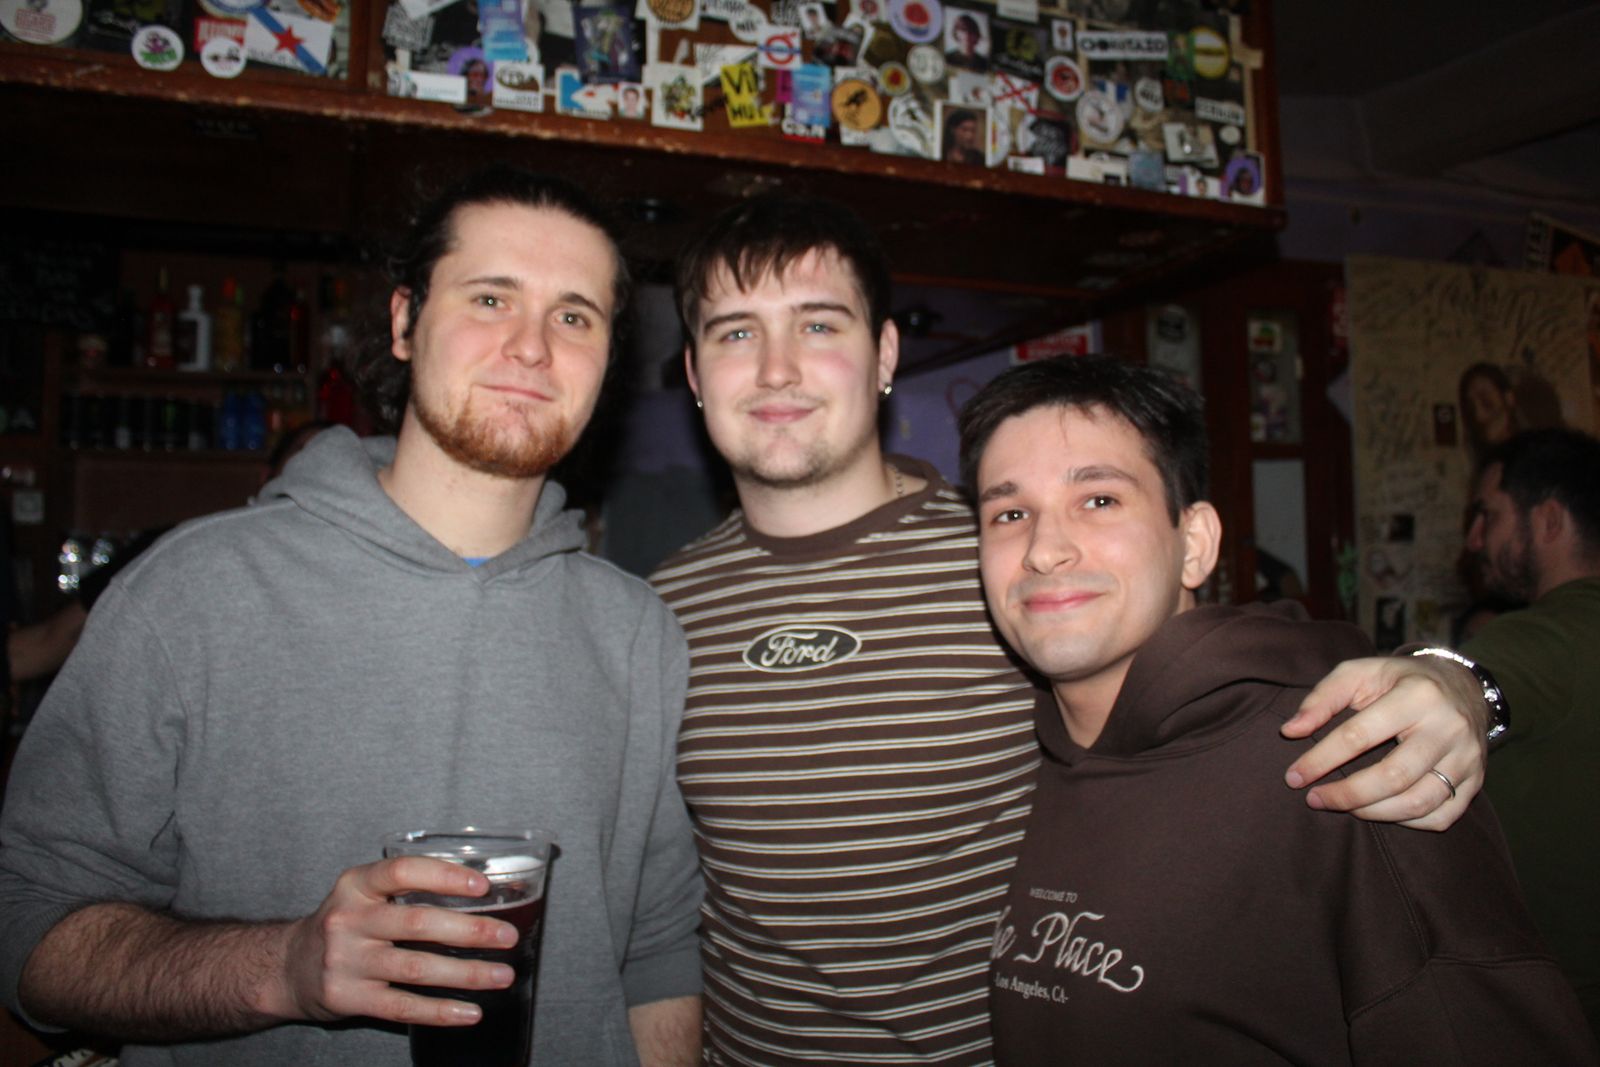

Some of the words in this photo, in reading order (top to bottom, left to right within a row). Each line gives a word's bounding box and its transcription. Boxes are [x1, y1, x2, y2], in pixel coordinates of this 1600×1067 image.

[761, 632, 838, 666] Ford
[1029, 887, 1065, 902] WELCOME
[1065, 891, 1078, 904] TO
[1014, 911, 1144, 992] Place
[1009, 976, 1050, 1001] Angeles,
